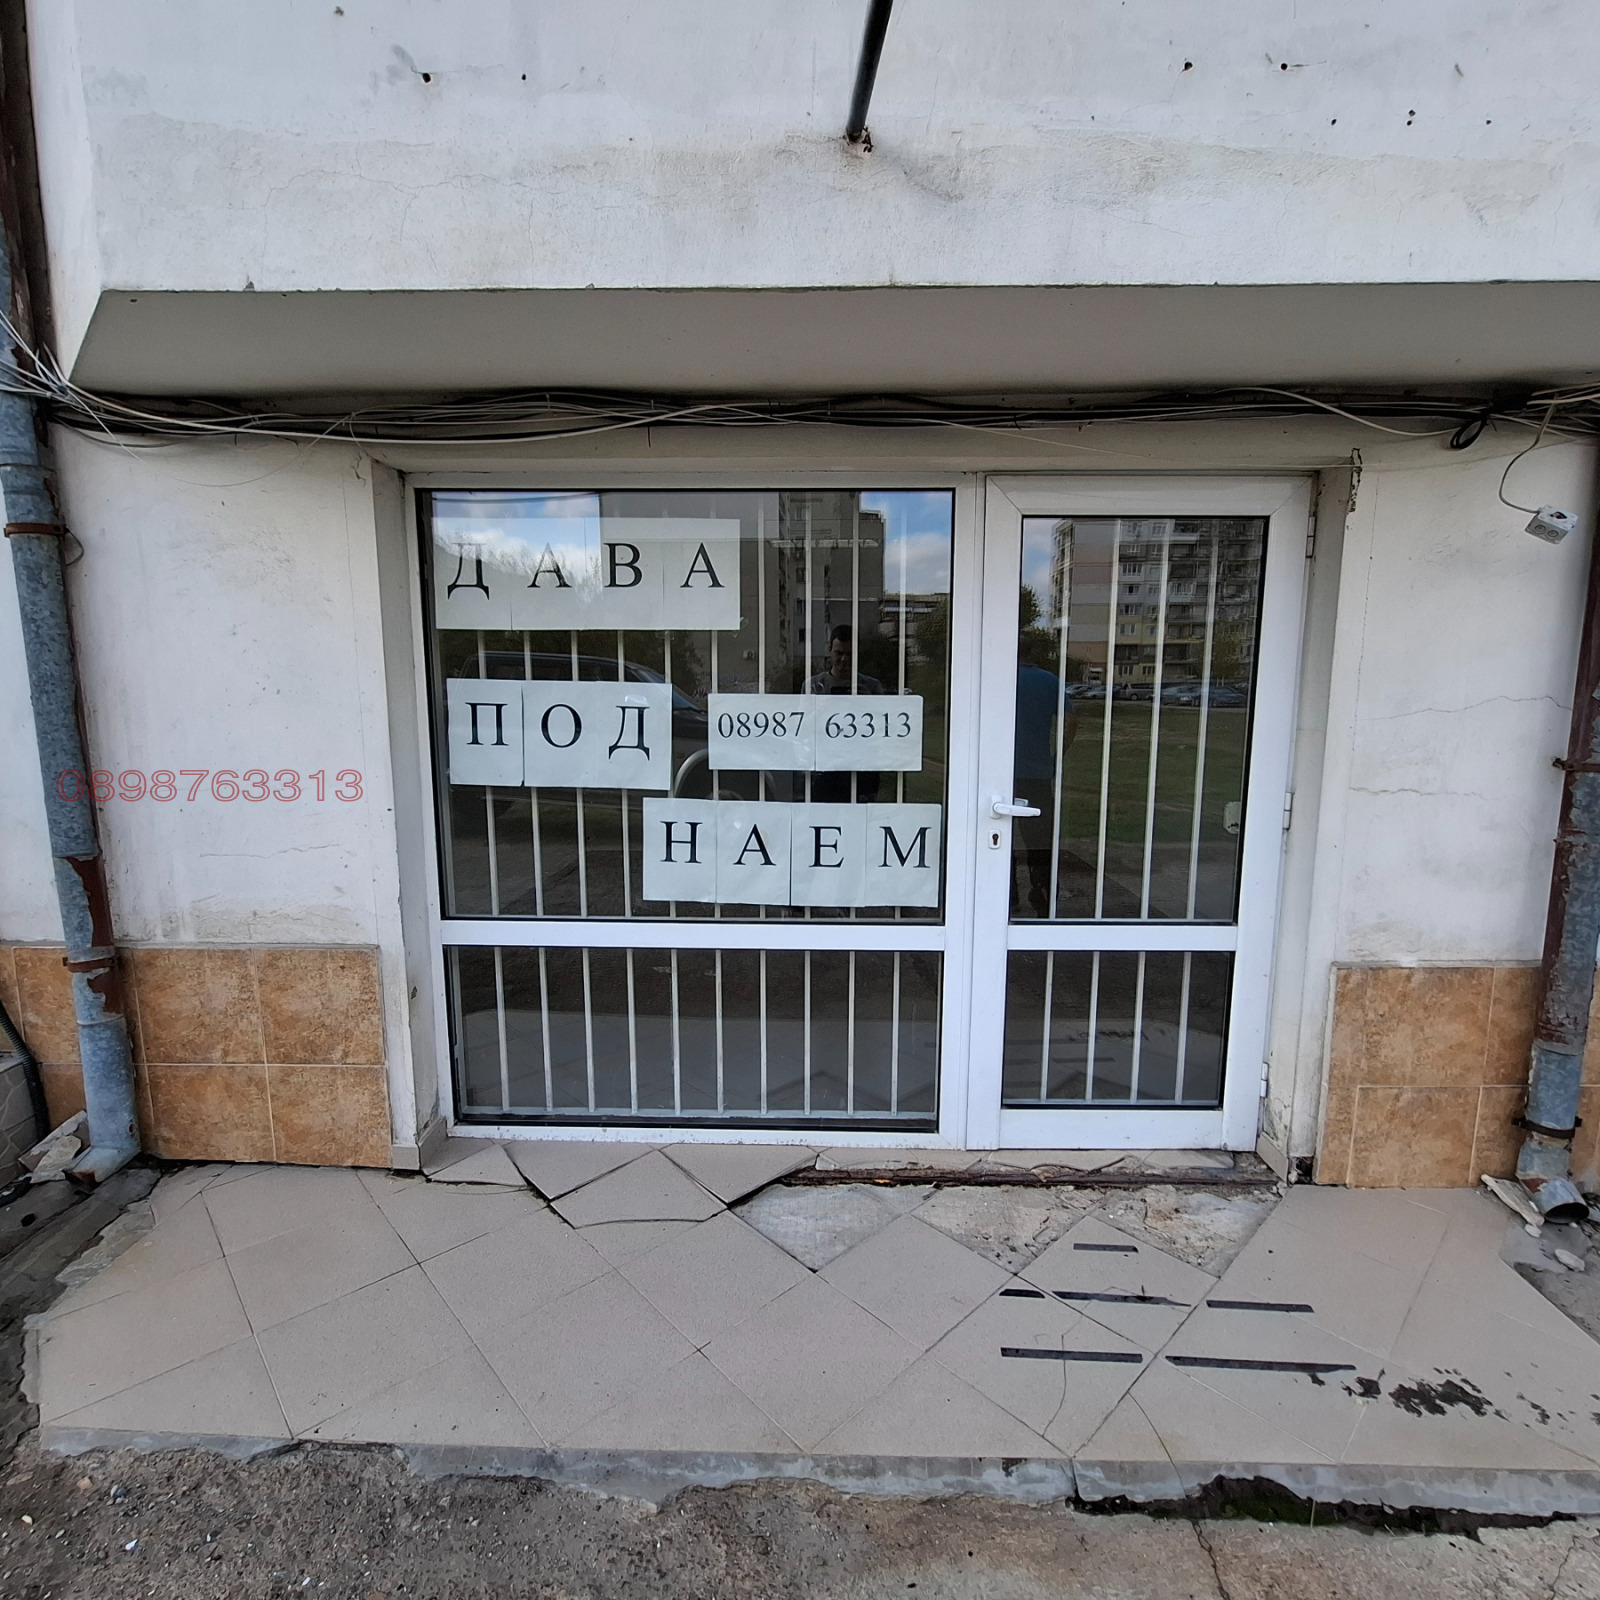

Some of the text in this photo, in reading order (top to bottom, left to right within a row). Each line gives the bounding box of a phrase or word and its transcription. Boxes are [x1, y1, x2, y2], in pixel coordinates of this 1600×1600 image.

[447, 541, 725, 600] ДАВА
[465, 701, 651, 761] ПОД
[717, 711, 912, 739] 08987 63313
[659, 820, 932, 869] НАЕМ
